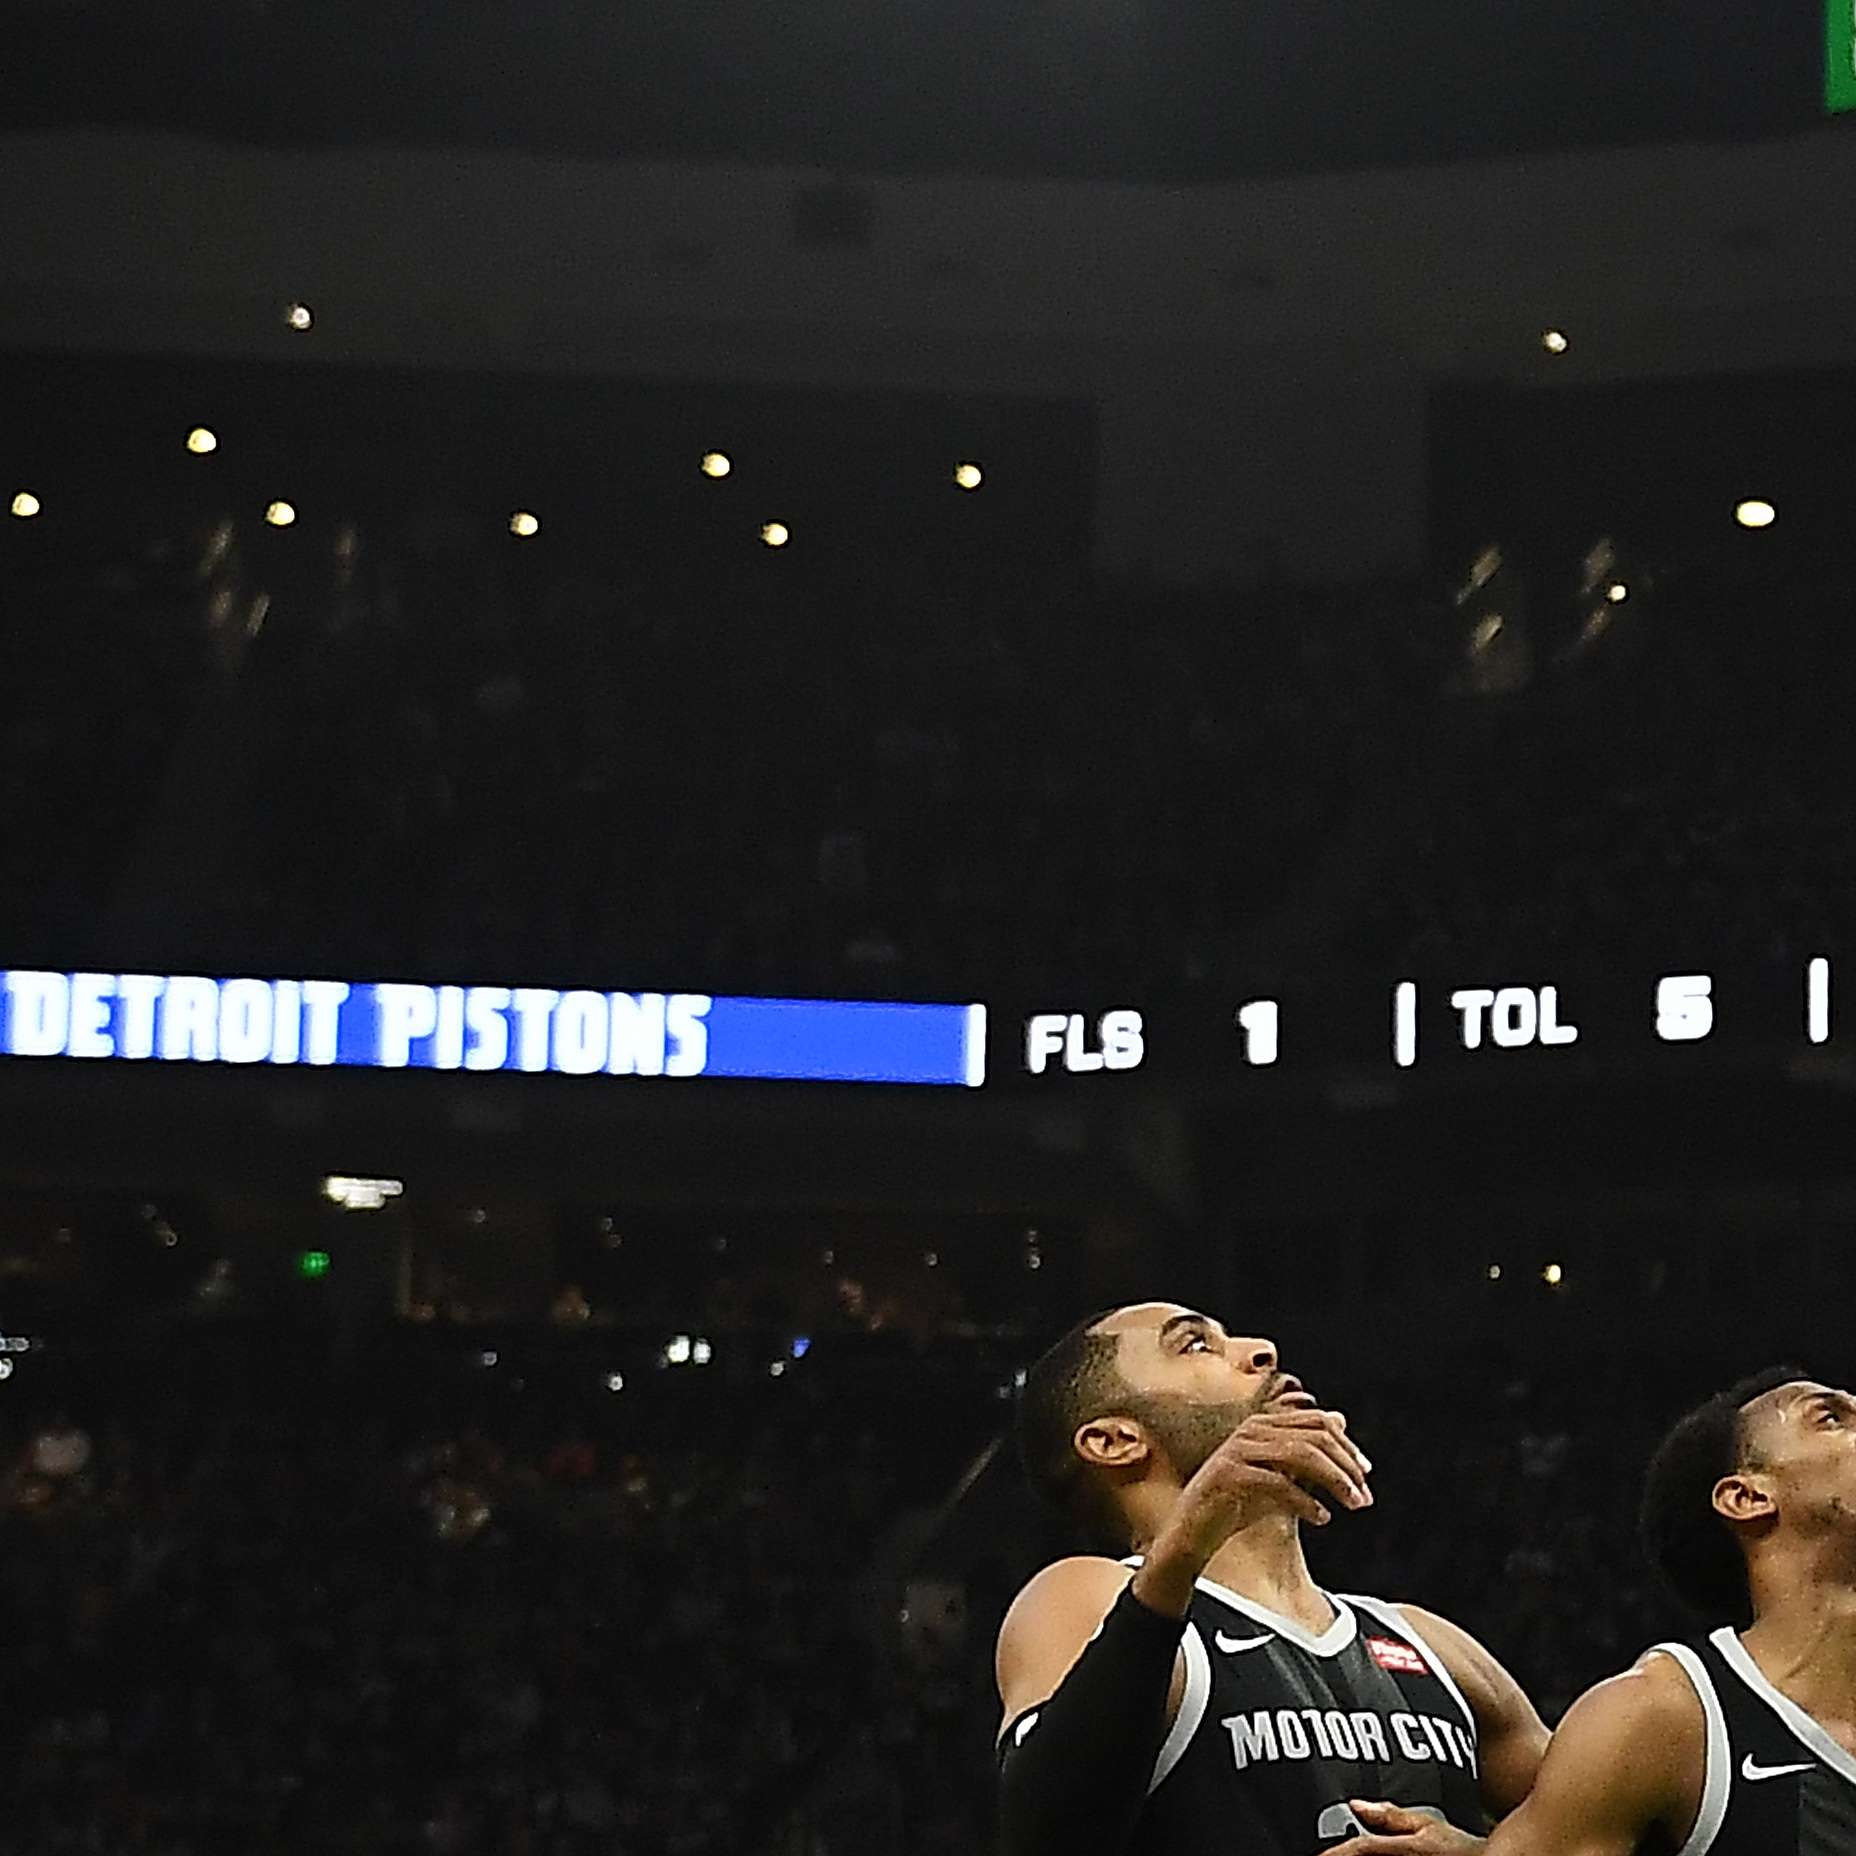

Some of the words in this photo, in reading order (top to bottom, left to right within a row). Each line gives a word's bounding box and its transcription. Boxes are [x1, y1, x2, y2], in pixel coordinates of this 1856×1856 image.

[3, 971, 350, 1065] DETROIT
[374, 983, 713, 1077] PISTONS
[1028, 1010, 1145, 1074] FLS
[1239, 1000, 1278, 1065] 1
[1450, 986, 1579, 1049] TOL
[1655, 975, 1713, 1040] 5
[1221, 1709, 1391, 1771] MOTOR
